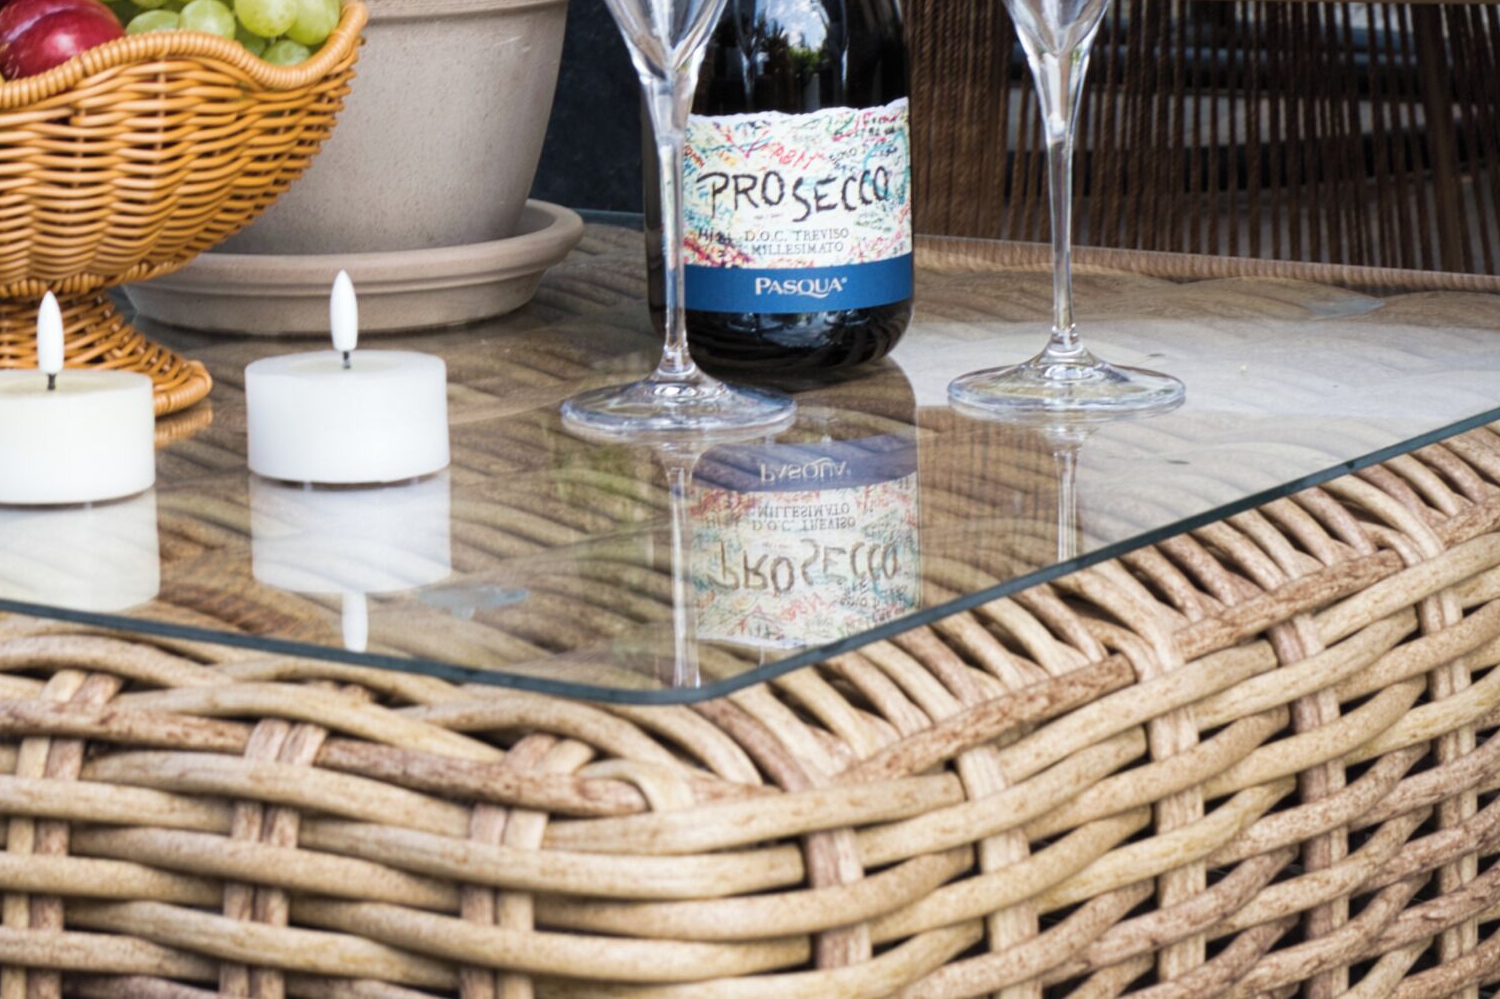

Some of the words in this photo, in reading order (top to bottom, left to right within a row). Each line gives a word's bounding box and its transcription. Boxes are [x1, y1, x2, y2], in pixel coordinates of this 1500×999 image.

[696, 165, 890, 222] PROSECCO
[744, 229, 788, 242] D.O.C.
[791, 227, 849, 242] TREVISO
[751, 241, 844, 256] MILLESIMATO
